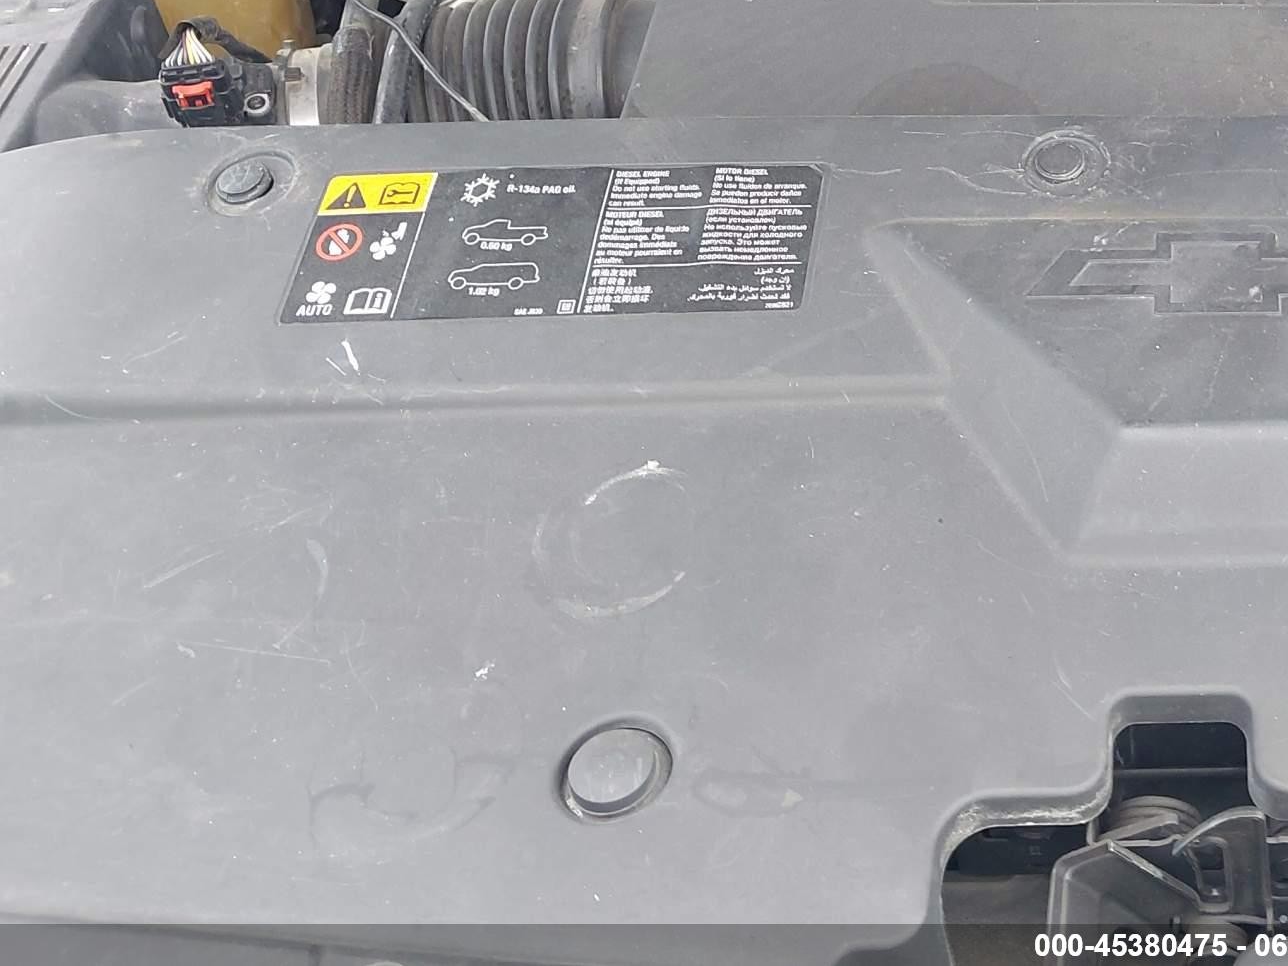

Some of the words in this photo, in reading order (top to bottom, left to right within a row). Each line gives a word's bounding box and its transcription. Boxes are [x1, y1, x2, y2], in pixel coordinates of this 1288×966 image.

[616, 170, 641, 178] DIESEL
[624, 178, 660, 186] Equipped)
[506, 184, 541, 194] R-134a
[651, 185, 678, 193] starting
[757, 209, 803, 217] ДВИГАТЕЛЬ
[296, 304, 333, 316] AUTO
